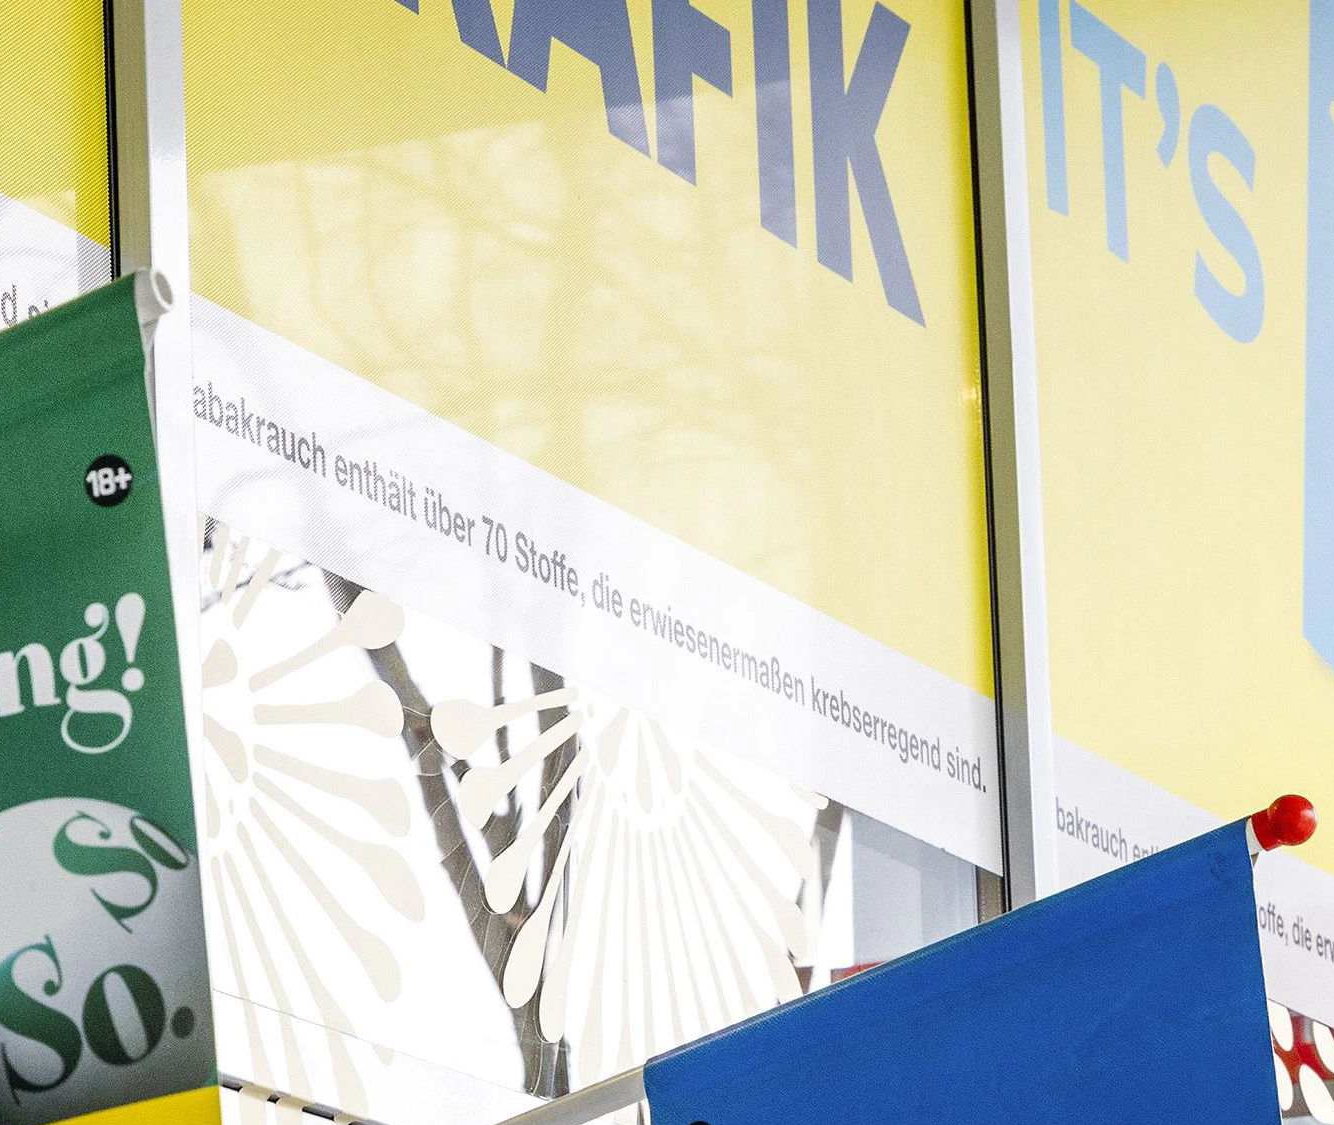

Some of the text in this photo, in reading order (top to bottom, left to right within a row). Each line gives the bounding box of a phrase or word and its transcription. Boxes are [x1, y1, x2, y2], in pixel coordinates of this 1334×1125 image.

[85, 464, 133, 498] 18+
[335, 455, 417, 521] enthält
[424, 487, 475, 547] über
[482, 514, 509, 563] 70
[514, 530, 585, 607] Stoffe,
[592, 573, 623, 618] die
[630, 596, 806, 707] erwiesenermaßen
[810, 675, 942, 772] krebserregend
[947, 746, 987, 793] sind.
[1292, 916, 1312, 951] die
